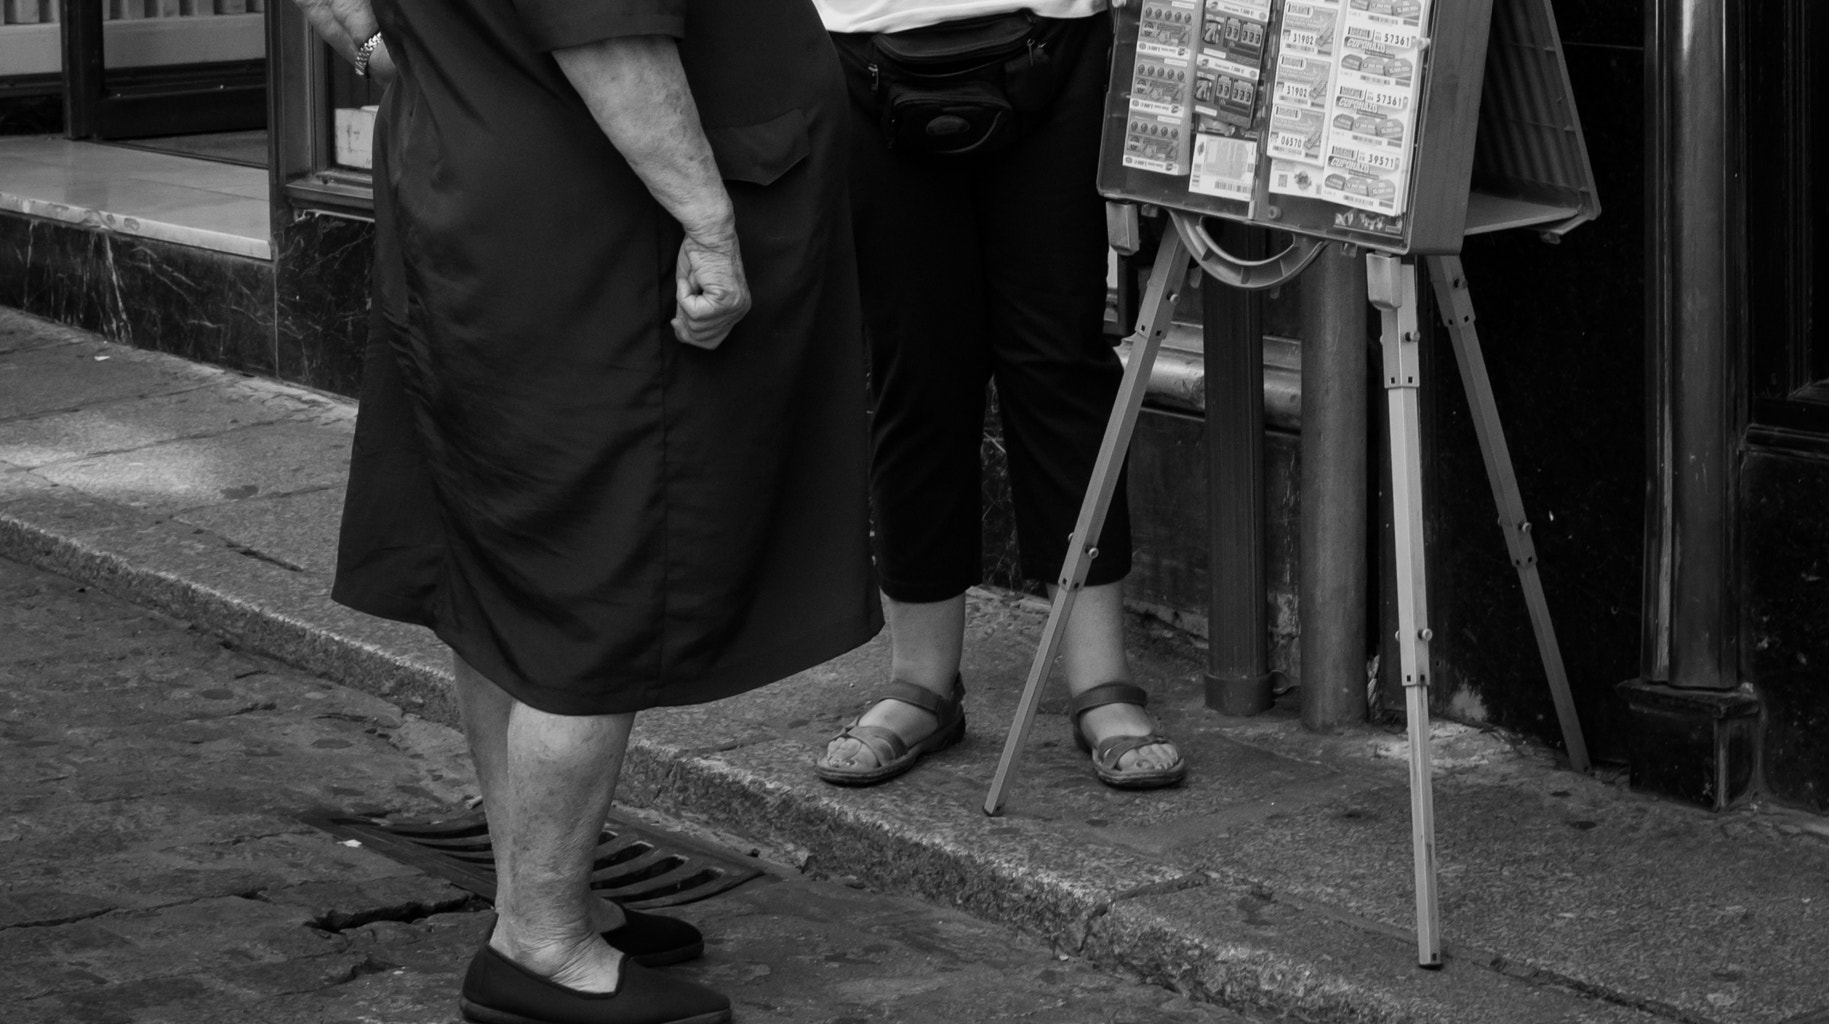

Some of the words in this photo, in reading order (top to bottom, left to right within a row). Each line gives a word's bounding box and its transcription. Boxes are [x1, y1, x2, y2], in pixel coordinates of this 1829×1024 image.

[1293, 33, 1314, 45] 31902
[1384, 33, 1410, 46] 57361
[1286, 85, 1307, 98] 31902
[1338, 97, 1379, 113] CUPONAZO
[1376, 93, 1402, 107] 57361
[1280, 136, 1302, 148] 06570
[1330, 157, 1370, 173] CUPONAZO
[1368, 154, 1394, 168] 39571
